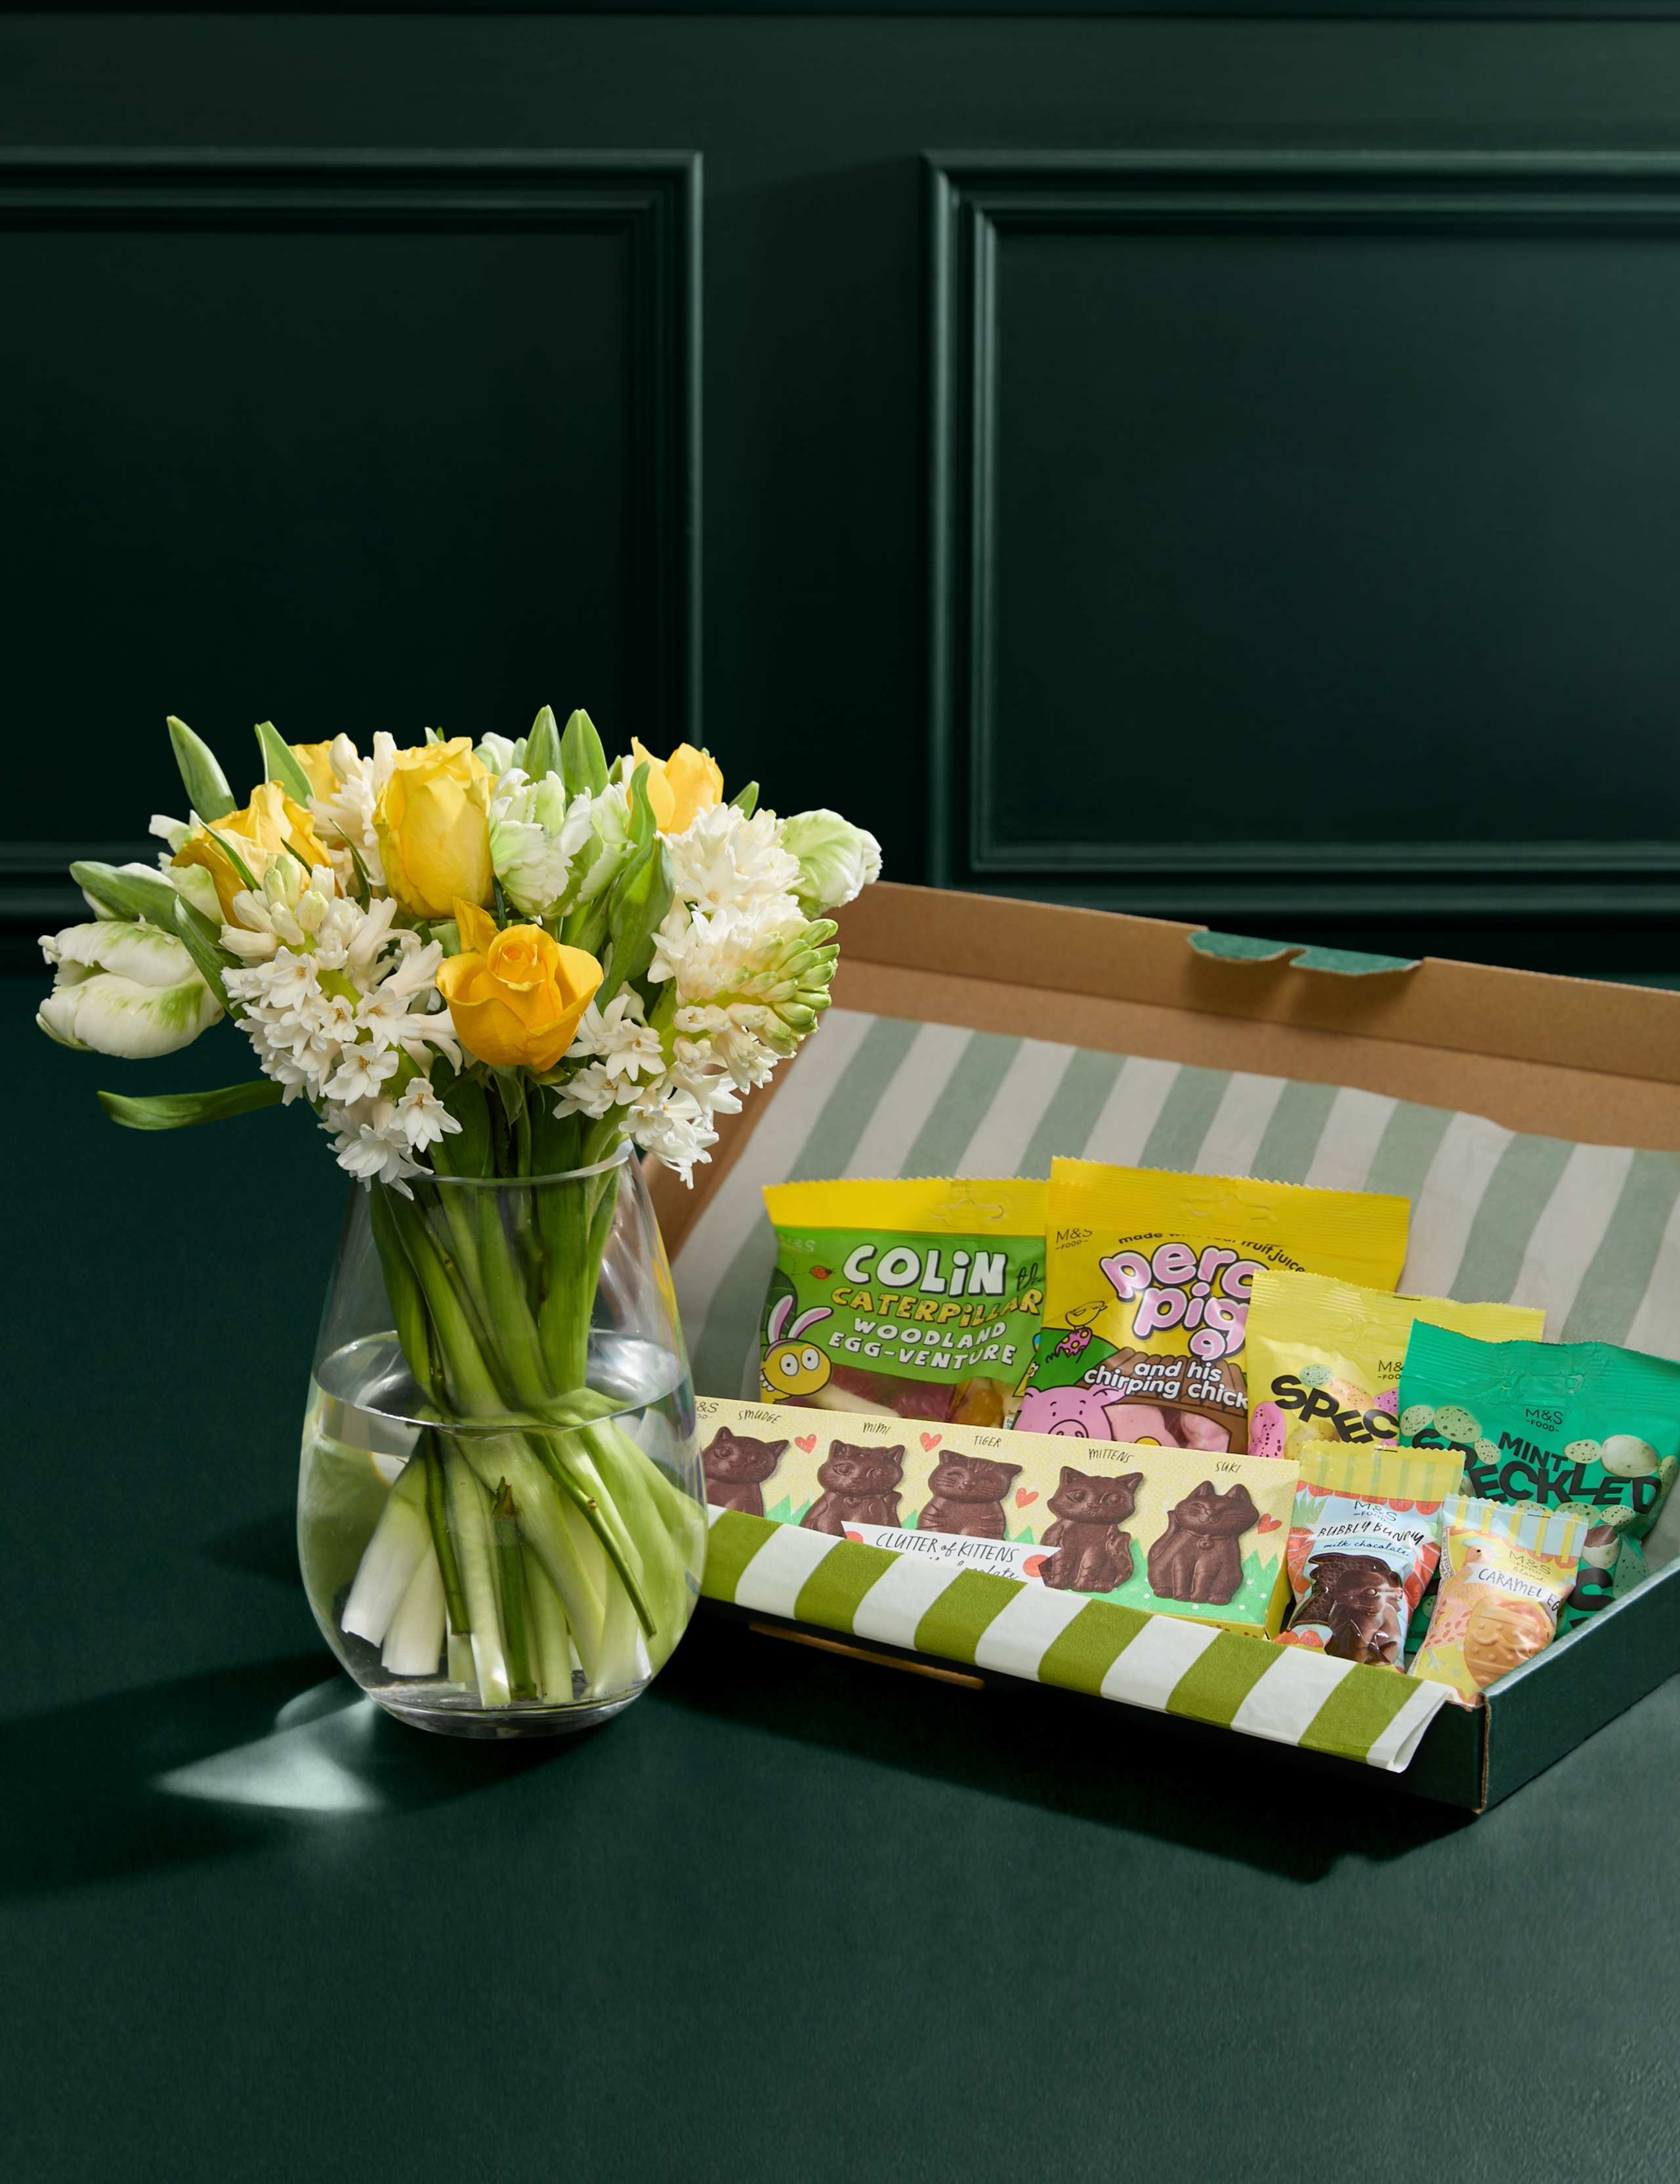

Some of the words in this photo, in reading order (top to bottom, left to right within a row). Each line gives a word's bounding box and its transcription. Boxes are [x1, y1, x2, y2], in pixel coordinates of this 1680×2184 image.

[1055, 1228, 1093, 1244] M&S
[1118, 1232, 1163, 1244] made
[1099, 1242, 1270, 1303] perc
[854, 1317, 1007, 1350] WOODLAND
[828, 1331, 1017, 1370] EGG-VENTURE
[1134, 1360, 1183, 1377] and
[1186, 1360, 1223, 1382] his
[1377, 1360, 1403, 1373] M&
[1083, 1365, 1181, 1399] chirping
[1187, 1380, 1248, 1410] chick
[694, 1400, 719, 1414] &S
[738, 1409, 782, 1424] SMUDGE
[1270, 1375, 1399, 1444] SPEC
[1524, 1408, 1563, 1425] M&S
[974, 1435, 1002, 1448] TIGER
[1498, 1431, 1569, 1473] MINT
[1088, 1448, 1135, 1464] MITTENS
[1215, 1461, 1242, 1474] SUKI
[1354, 1500, 1398, 1522] M&S
[1318, 1521, 1372, 1538] BUBBLY
[1373, 1522, 1425, 1546] BUNNY
[876, 1532, 938, 1553] CLUTTER
[940, 1541, 956, 1557] of
[957, 1540, 1020, 1563] KITTENS
[1322, 1540, 1351, 1549] milk
[1354, 1540, 1410, 1557] chocolate
[1509, 1550, 1551, 1575] M&S
[1478, 1568, 1543, 1599] CARAMEL
[1547, 1593, 1561, 1611] EG
